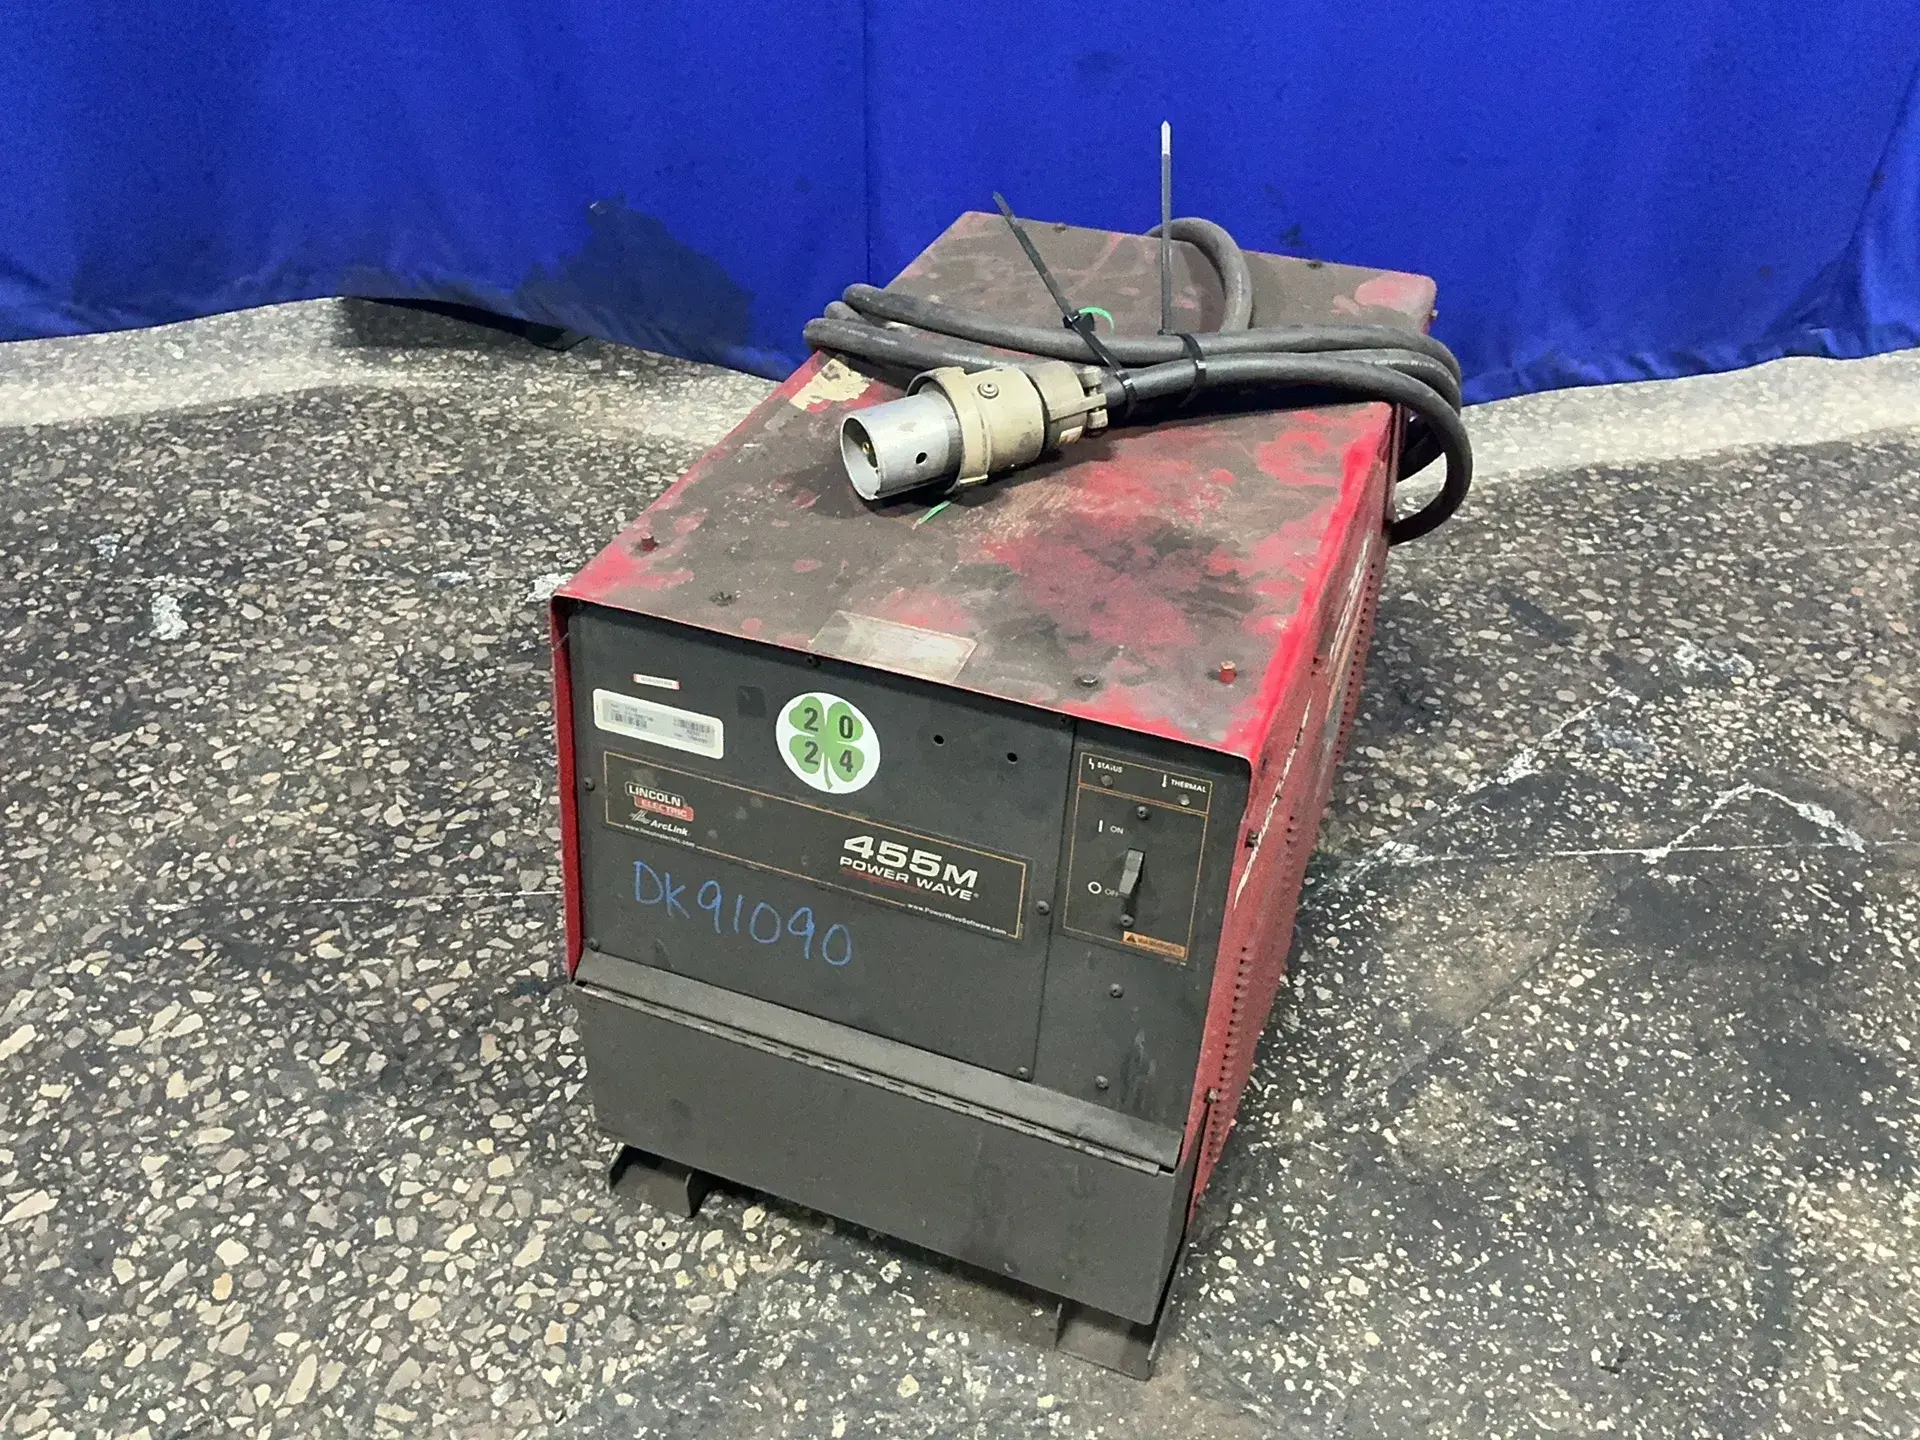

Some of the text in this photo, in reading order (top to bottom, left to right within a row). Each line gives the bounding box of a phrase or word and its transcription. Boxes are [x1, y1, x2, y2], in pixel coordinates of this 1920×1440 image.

[1096, 761, 1123, 774] STATUS
[1170, 778, 1206, 793] THERMAL
[628, 784, 681, 807] LINCOLN
[641, 798, 688, 818] ELECTRIC
[650, 819, 689, 836] ArcLink
[1109, 825, 1125, 835] ON
[843, 835, 978, 889] 455M
[839, 856, 972, 902] POWER WAVE
